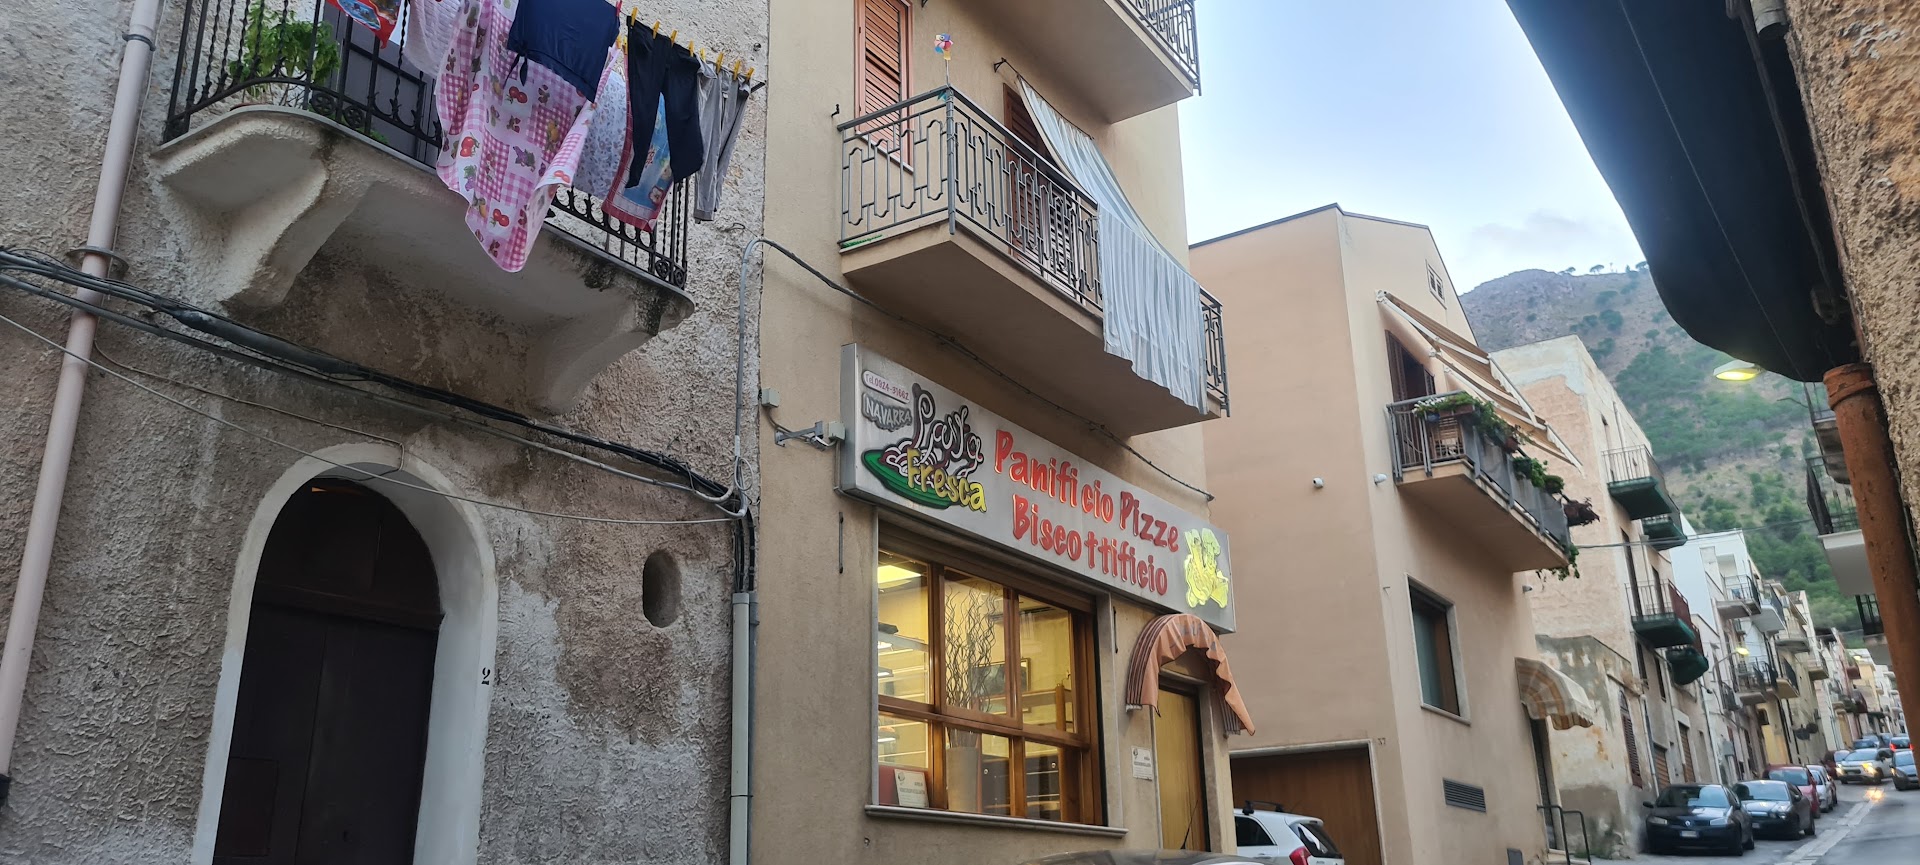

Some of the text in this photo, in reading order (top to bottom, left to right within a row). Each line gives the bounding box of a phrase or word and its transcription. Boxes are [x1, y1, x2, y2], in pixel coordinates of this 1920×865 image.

[865, 396, 912, 427] NAVARRA
[914, 391, 985, 463] Pasta
[906, 447, 987, 512] Fresca
[994, 429, 1179, 552] Panificio Pizze
[1012, 494, 1168, 596] Biscottificio
